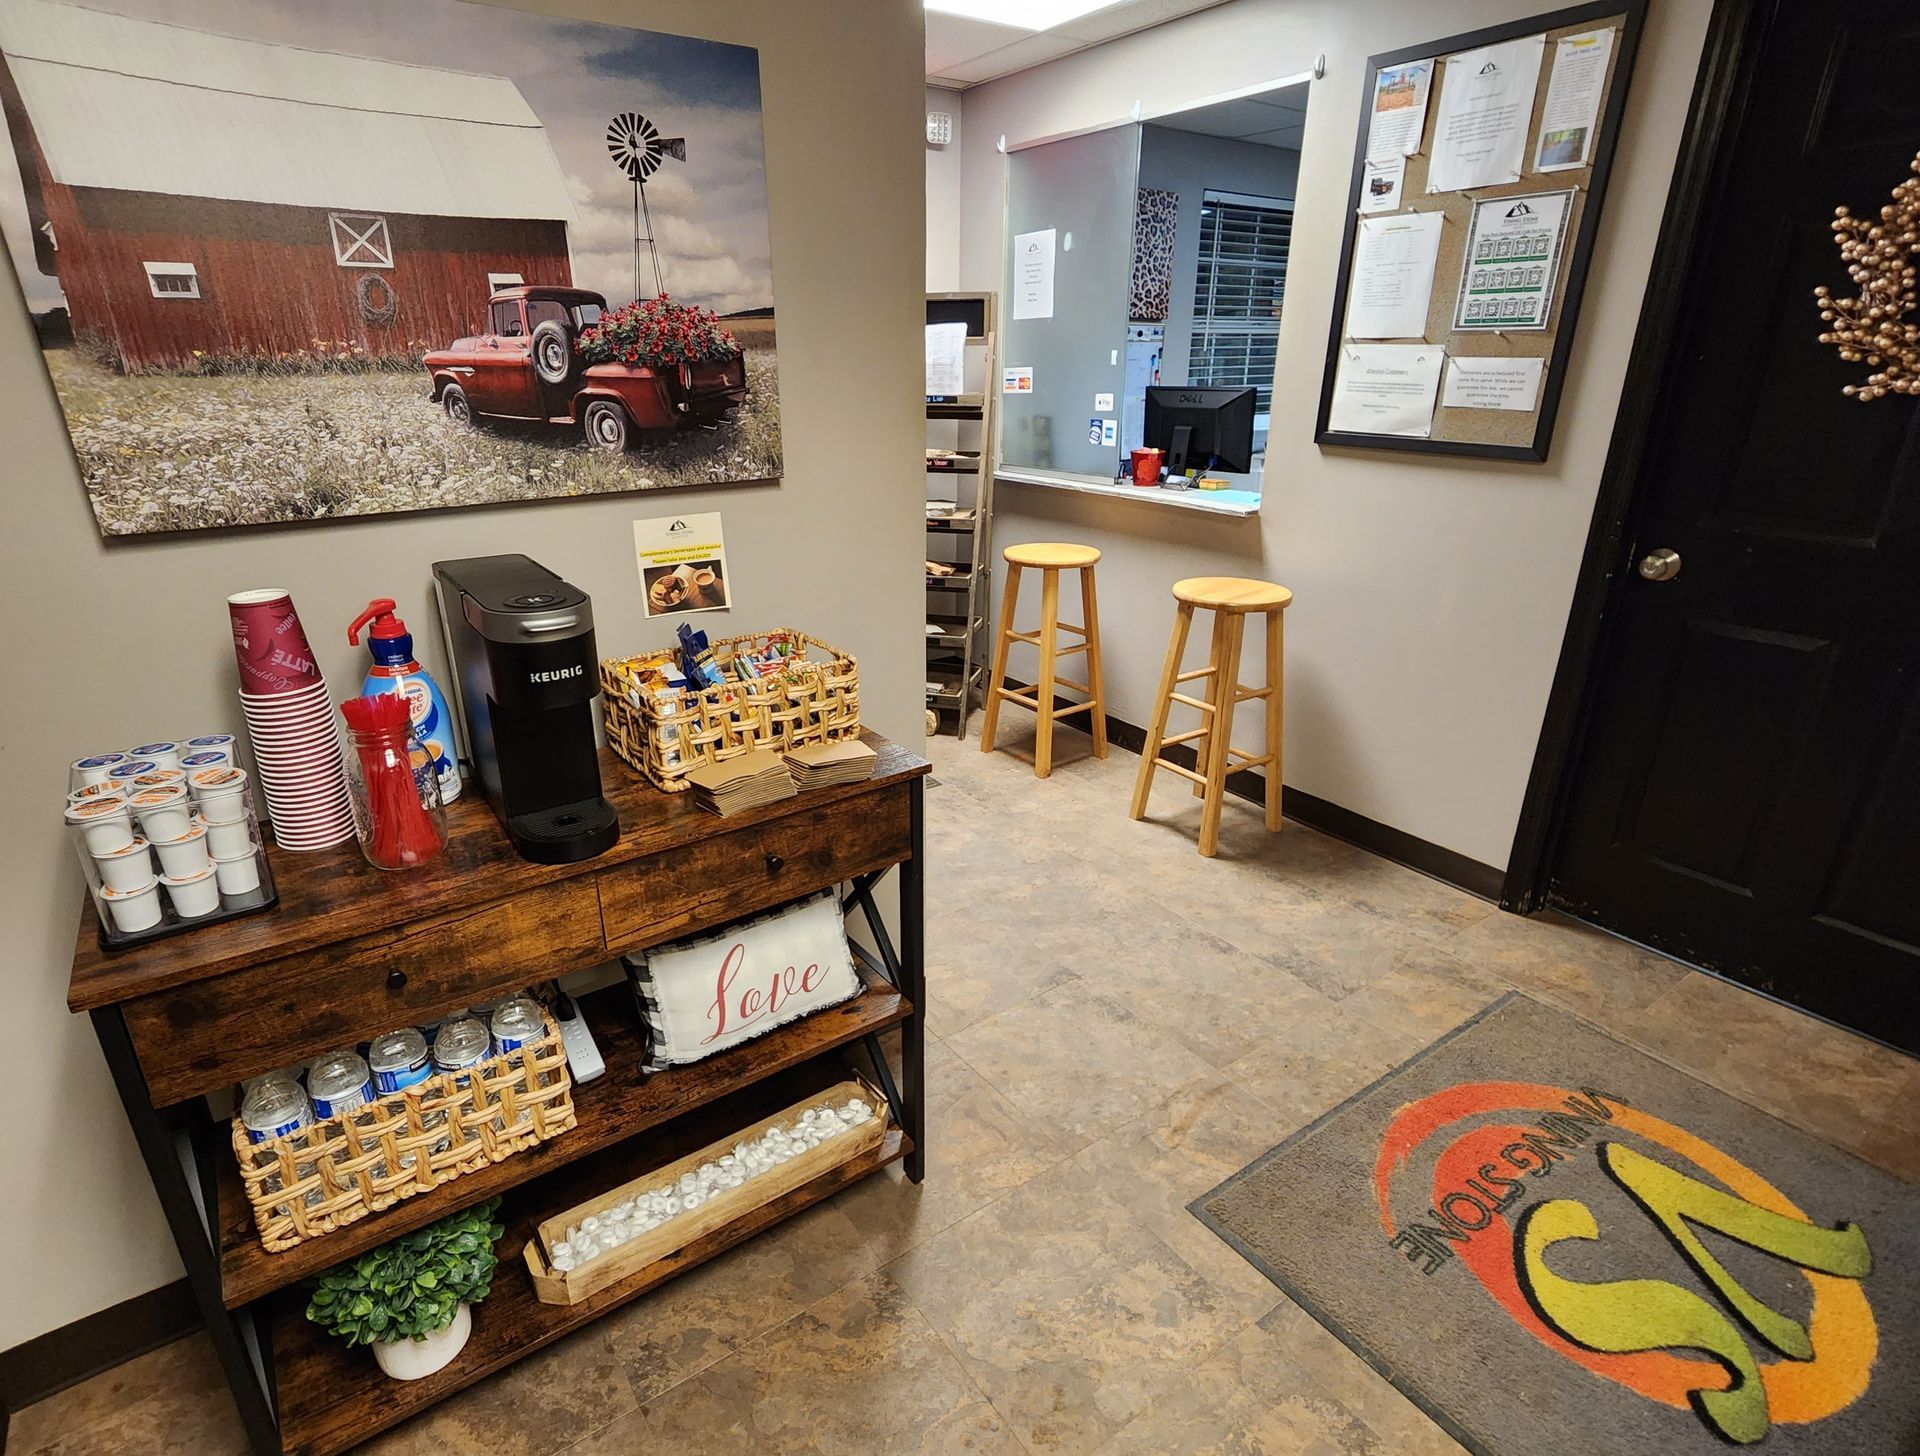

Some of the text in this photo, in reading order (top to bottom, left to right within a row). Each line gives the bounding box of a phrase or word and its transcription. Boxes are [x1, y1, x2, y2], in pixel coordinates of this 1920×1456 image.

[1179, 394, 1203, 403] DELL
[640, 549, 673, 558] Complimentary
[530, 665, 583, 683] KEURIG
[700, 944, 830, 1045] Love
